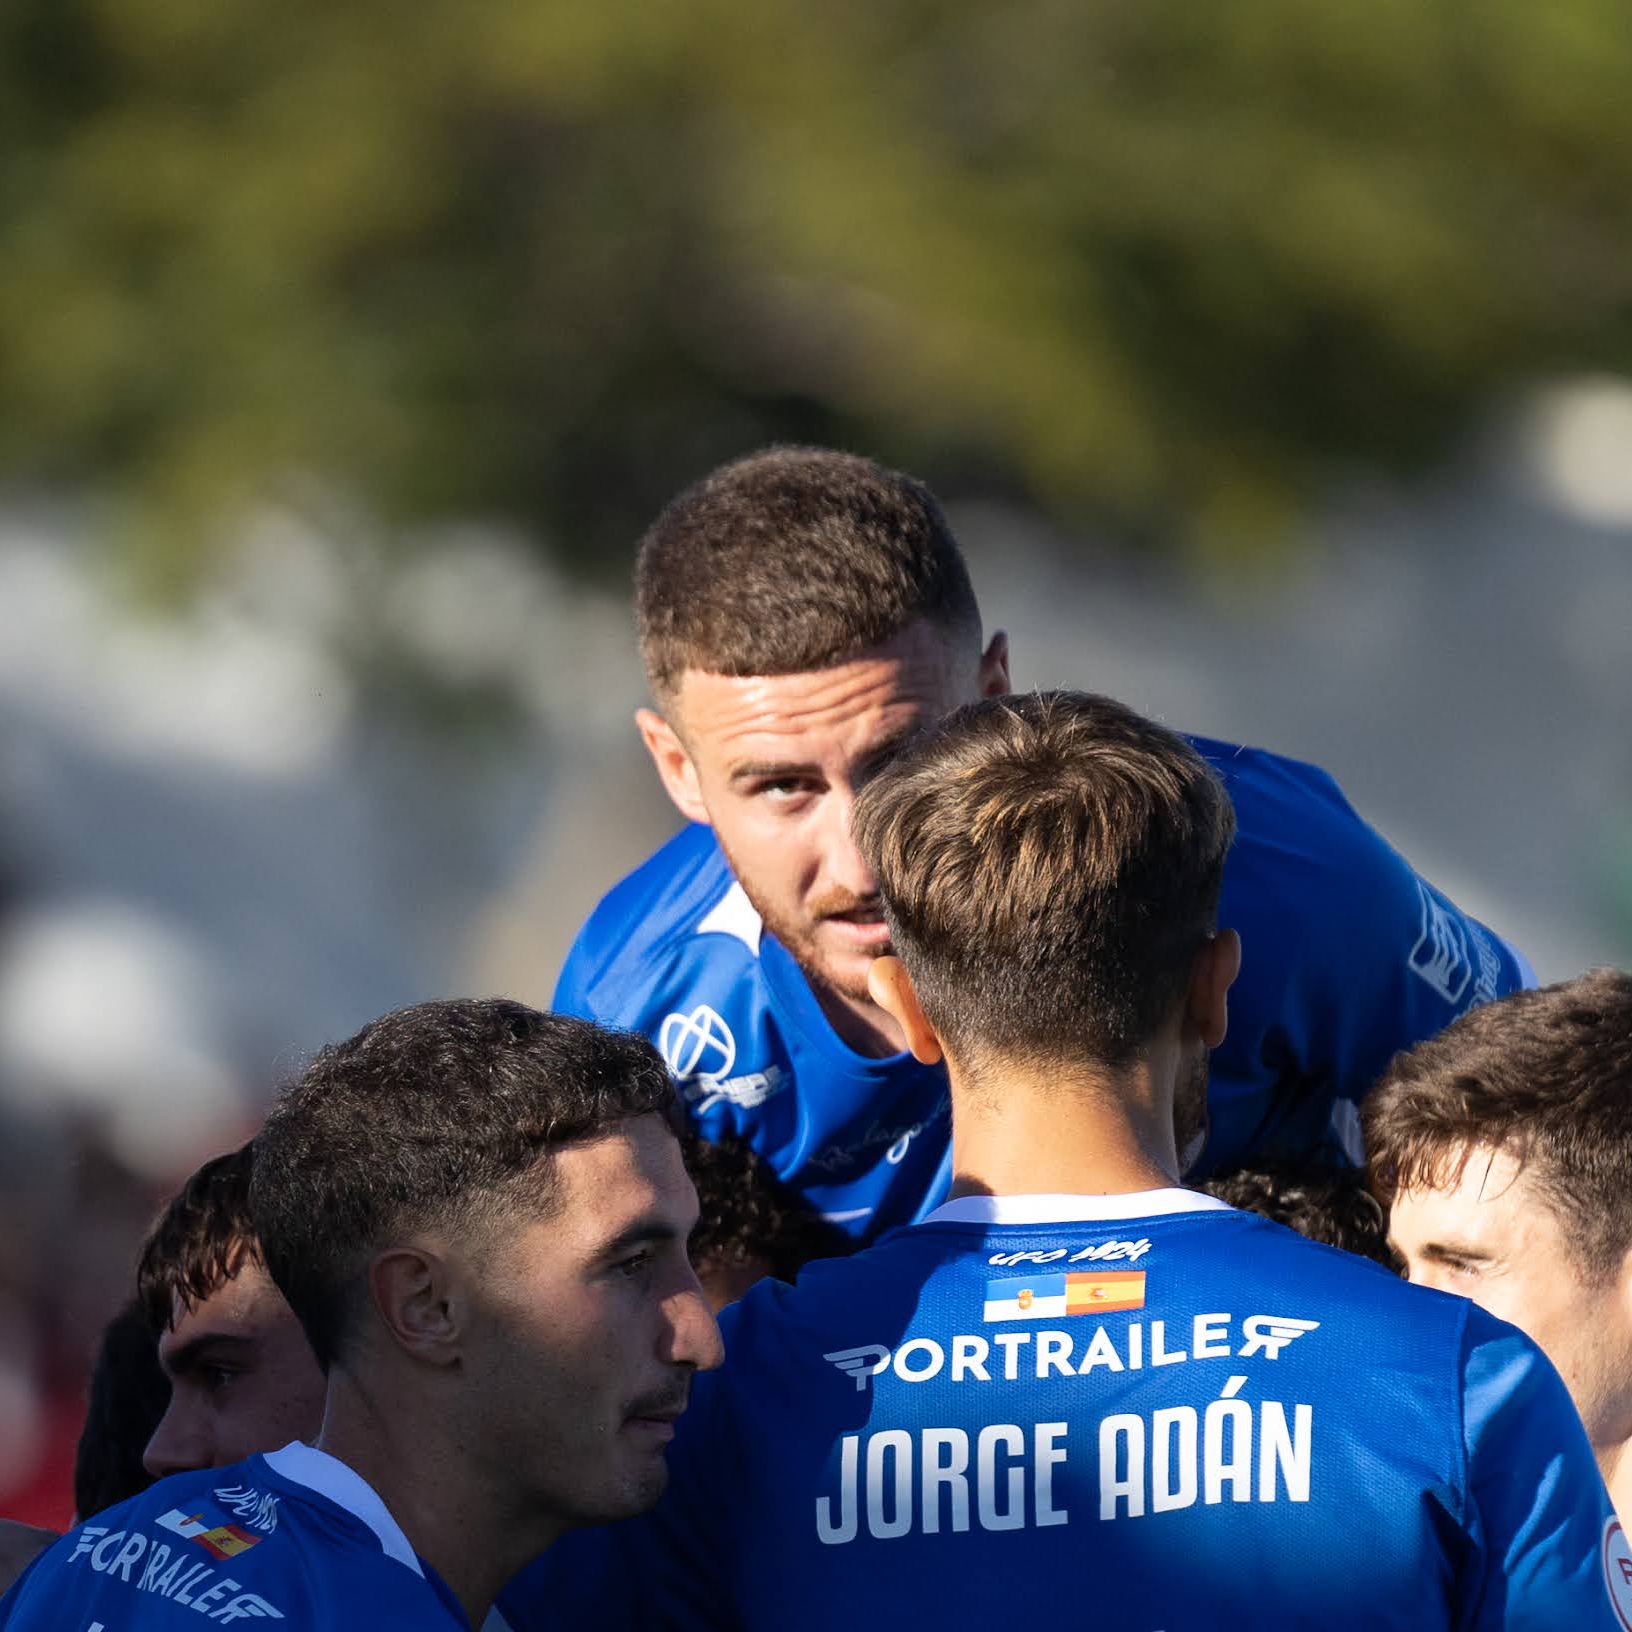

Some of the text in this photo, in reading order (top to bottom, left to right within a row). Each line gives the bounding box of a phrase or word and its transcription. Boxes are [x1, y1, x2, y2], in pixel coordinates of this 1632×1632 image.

[823, 1312, 1321, 1392] PORTRAILER
[815, 1375, 1313, 1546] JORGE ADÁN
